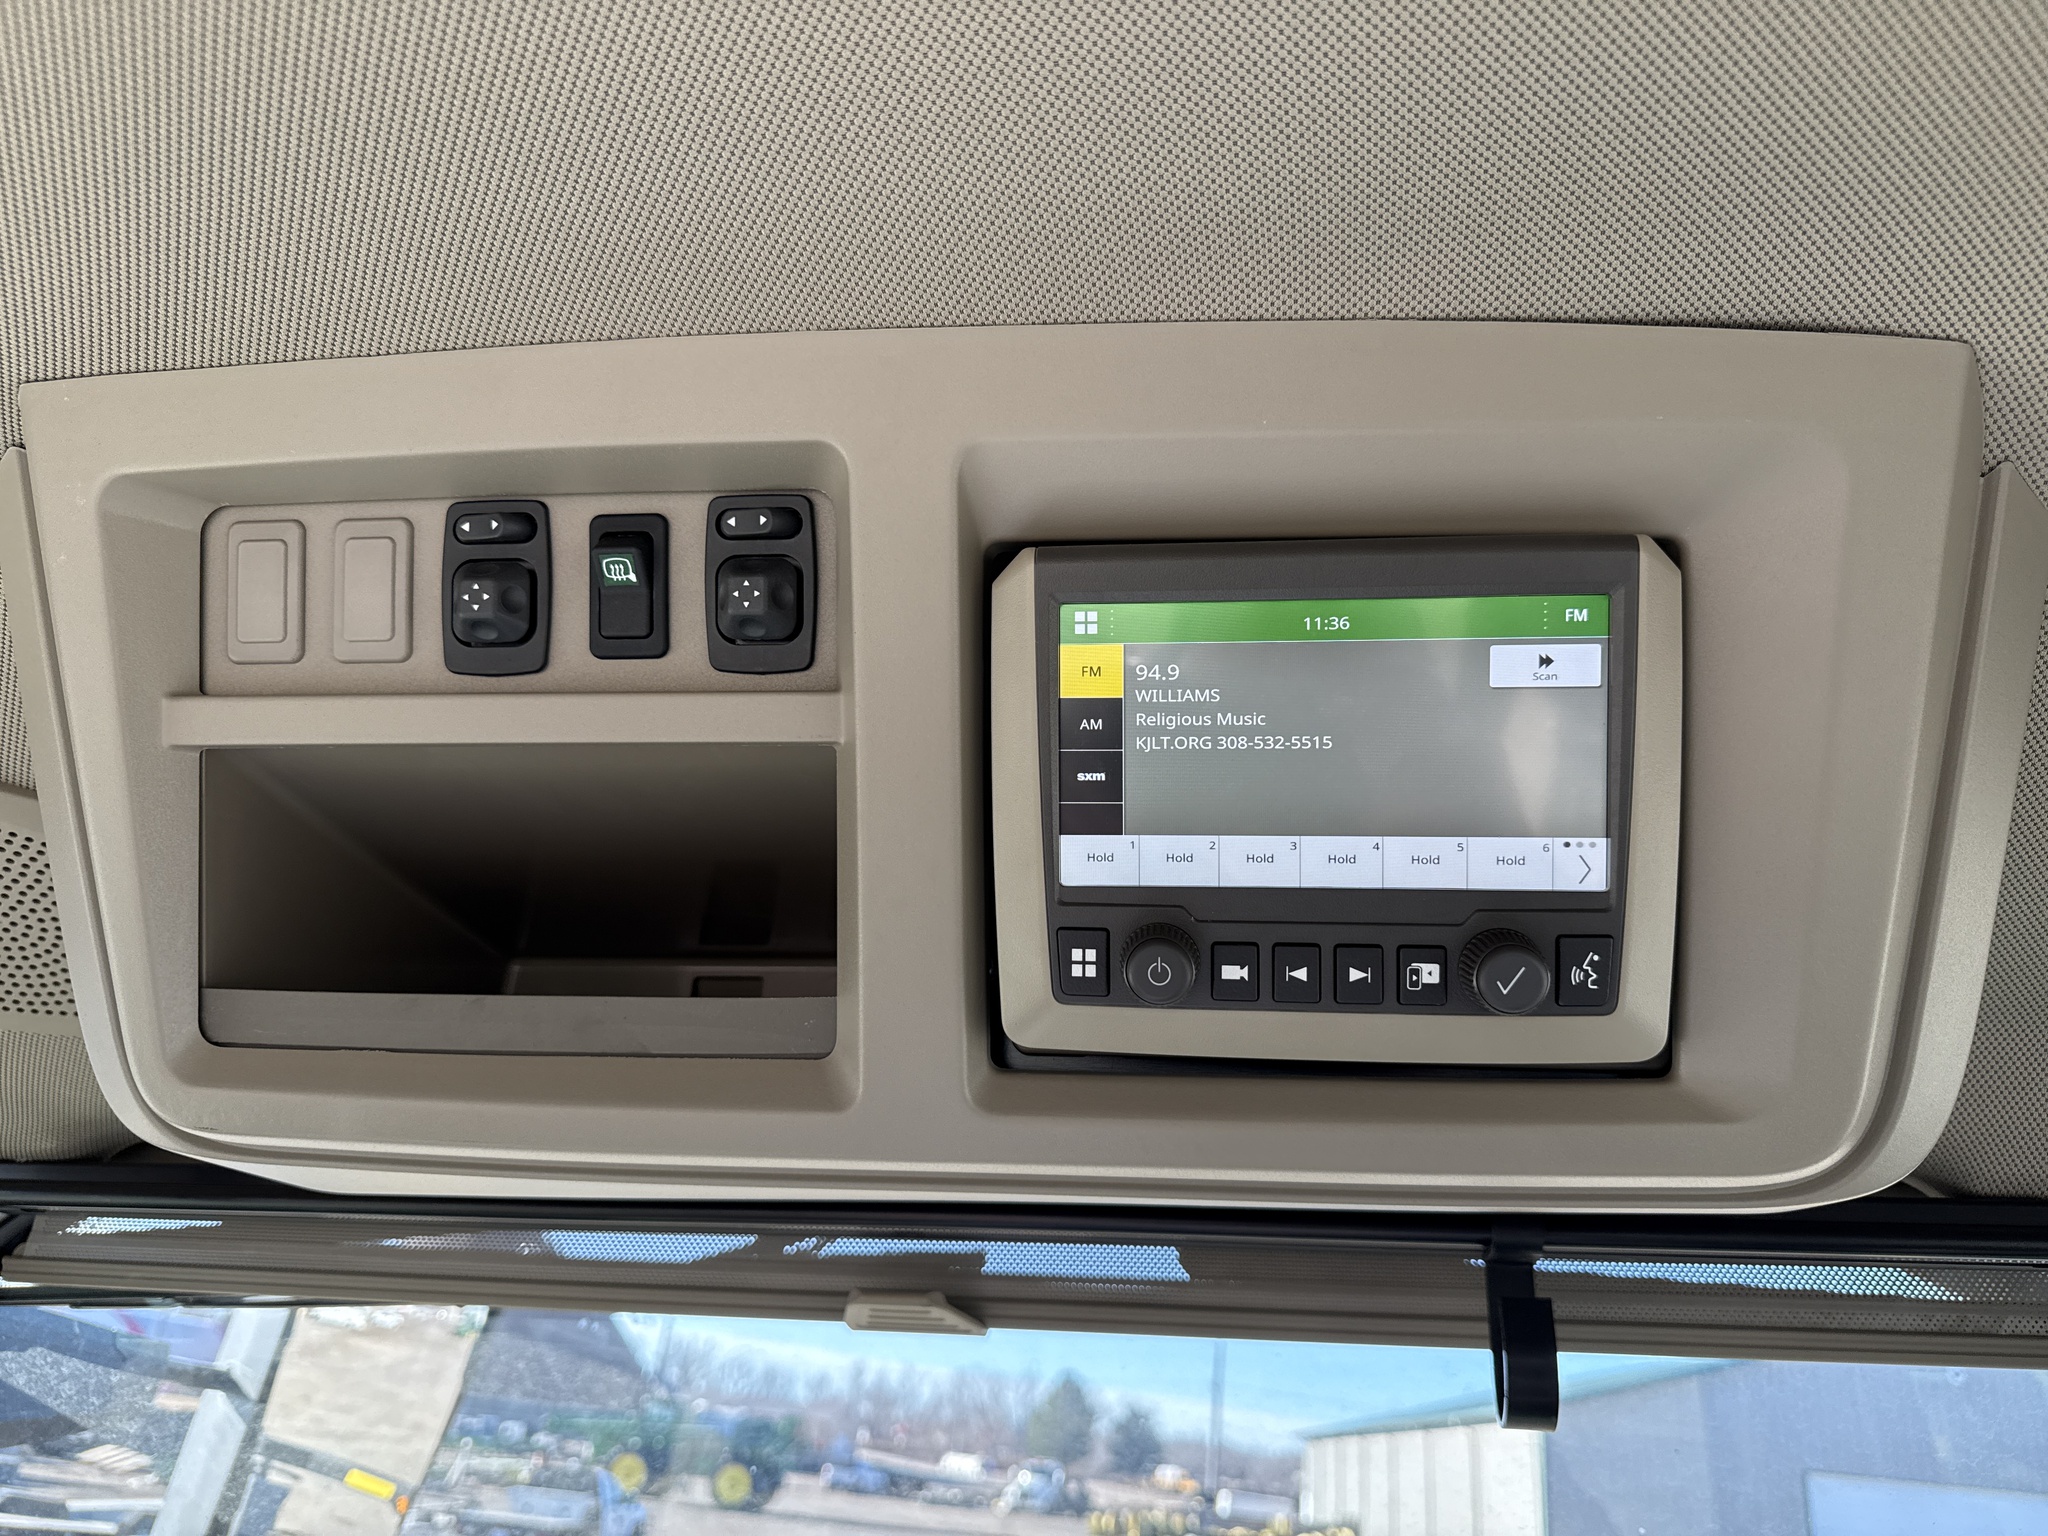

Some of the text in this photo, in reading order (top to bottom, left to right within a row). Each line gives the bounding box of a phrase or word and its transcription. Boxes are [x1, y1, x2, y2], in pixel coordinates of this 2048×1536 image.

[1566, 608, 1588, 622] FM
[1304, 617, 1349, 630] 11:36
[1082, 665, 1102, 678] FM
[1135, 664, 1180, 680] 94.9
[1532, 671, 1558, 681] Scan
[1135, 689, 1220, 702] WILLIAMS
[1080, 718, 1103, 731] AM
[1137, 712, 1265, 729] Religious Music
[1137, 736, 1332, 752] KJLT.ORG 308-532-5515
[1077, 772, 1106, 782] sxm
[1130, 840, 1135, 850] 1
[1209, 840, 1216, 850] 2
[1290, 841, 1297, 851] 3
[1372, 842, 1380, 851] 4
[1457, 842, 1465, 852] 5
[1542, 843, 1550, 853] 6
[1087, 852, 1114, 863] Hold
[1166, 852, 1194, 863] Hold
[1246, 853, 1274, 864] Hold
[1328, 854, 1357, 865] Hold
[1411, 854, 1440, 865] Hold
[1496, 855, 1526, 866] Hold
